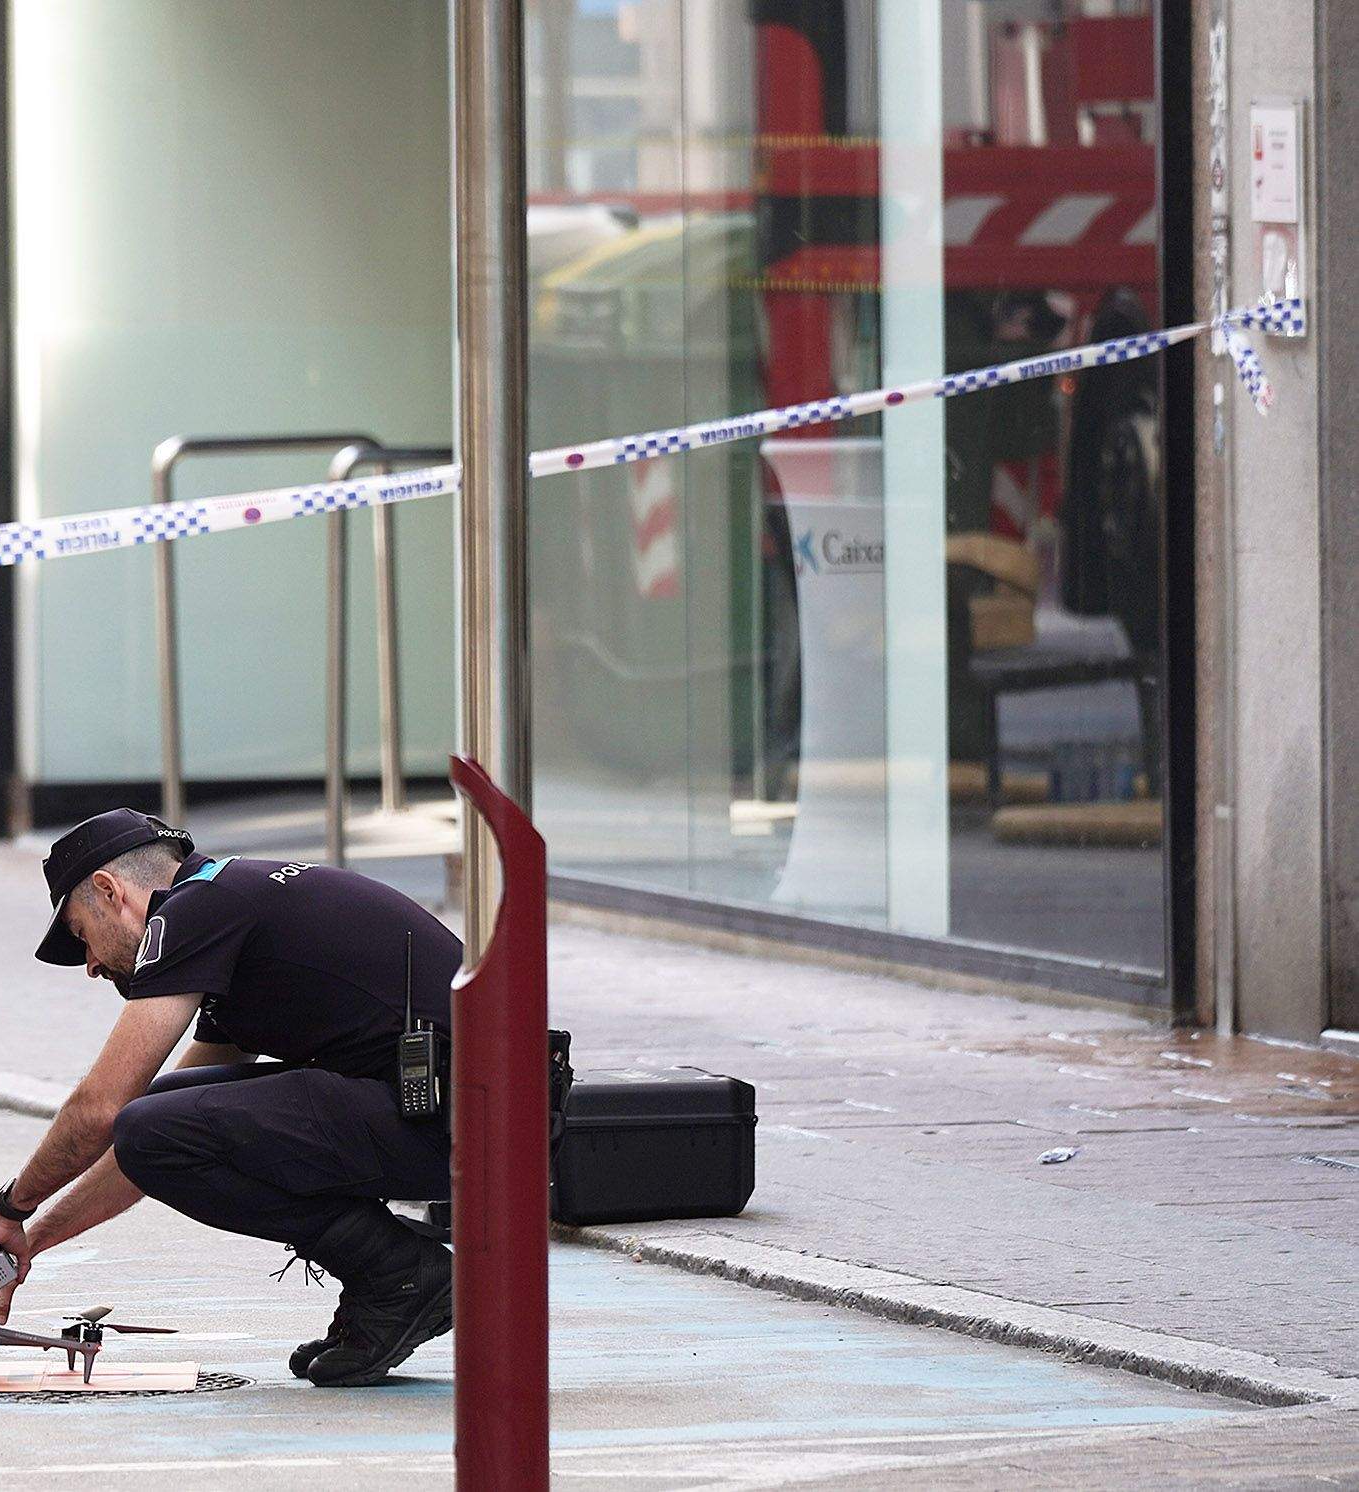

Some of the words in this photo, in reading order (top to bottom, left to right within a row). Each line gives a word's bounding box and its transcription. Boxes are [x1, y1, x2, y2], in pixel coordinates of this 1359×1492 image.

[1019, 354, 1082, 380] POLICIA
[378, 479, 443, 500] POLICIA
[55, 530, 121, 551] POLICIA
